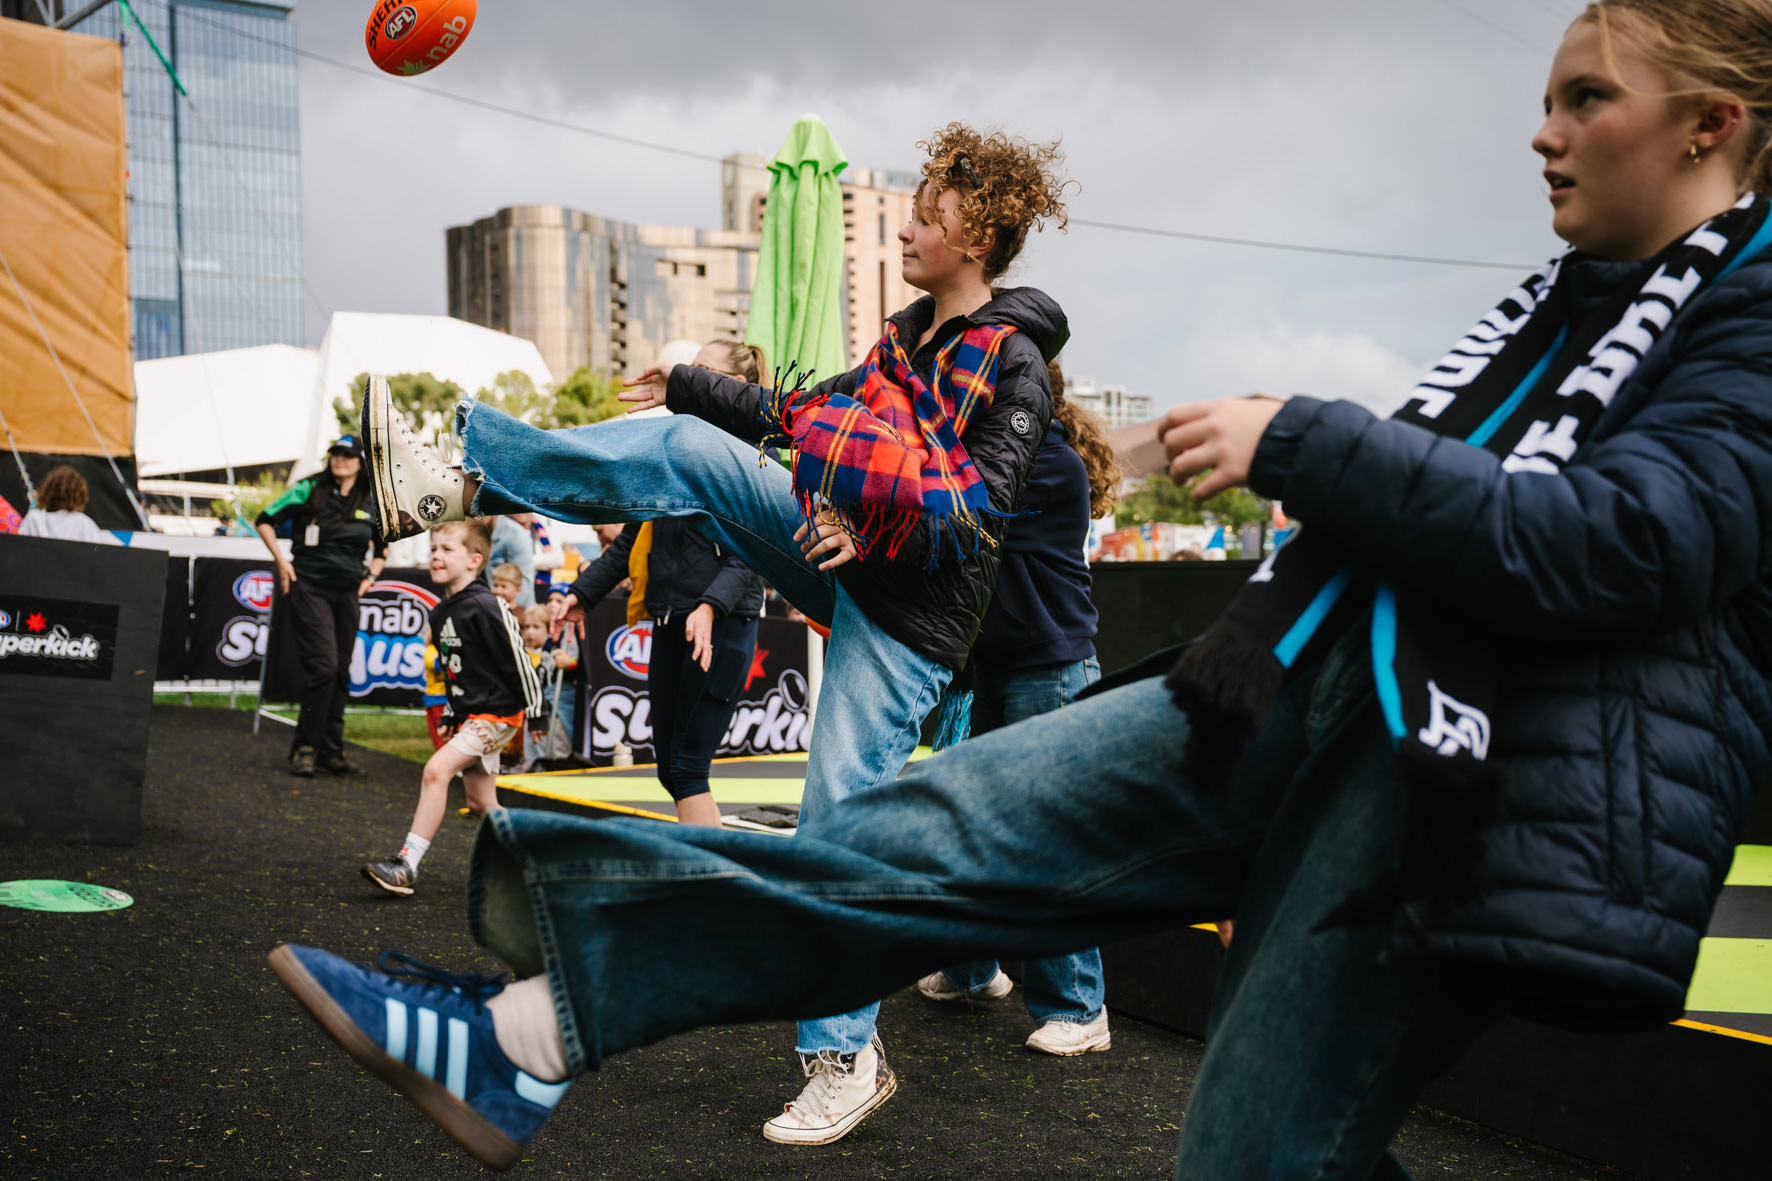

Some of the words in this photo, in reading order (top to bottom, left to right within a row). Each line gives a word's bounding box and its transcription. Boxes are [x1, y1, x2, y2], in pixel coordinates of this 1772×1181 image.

[387, 9, 415, 39] AFL
[425, 15, 467, 60] nab
[359, 600, 422, 634] nab
